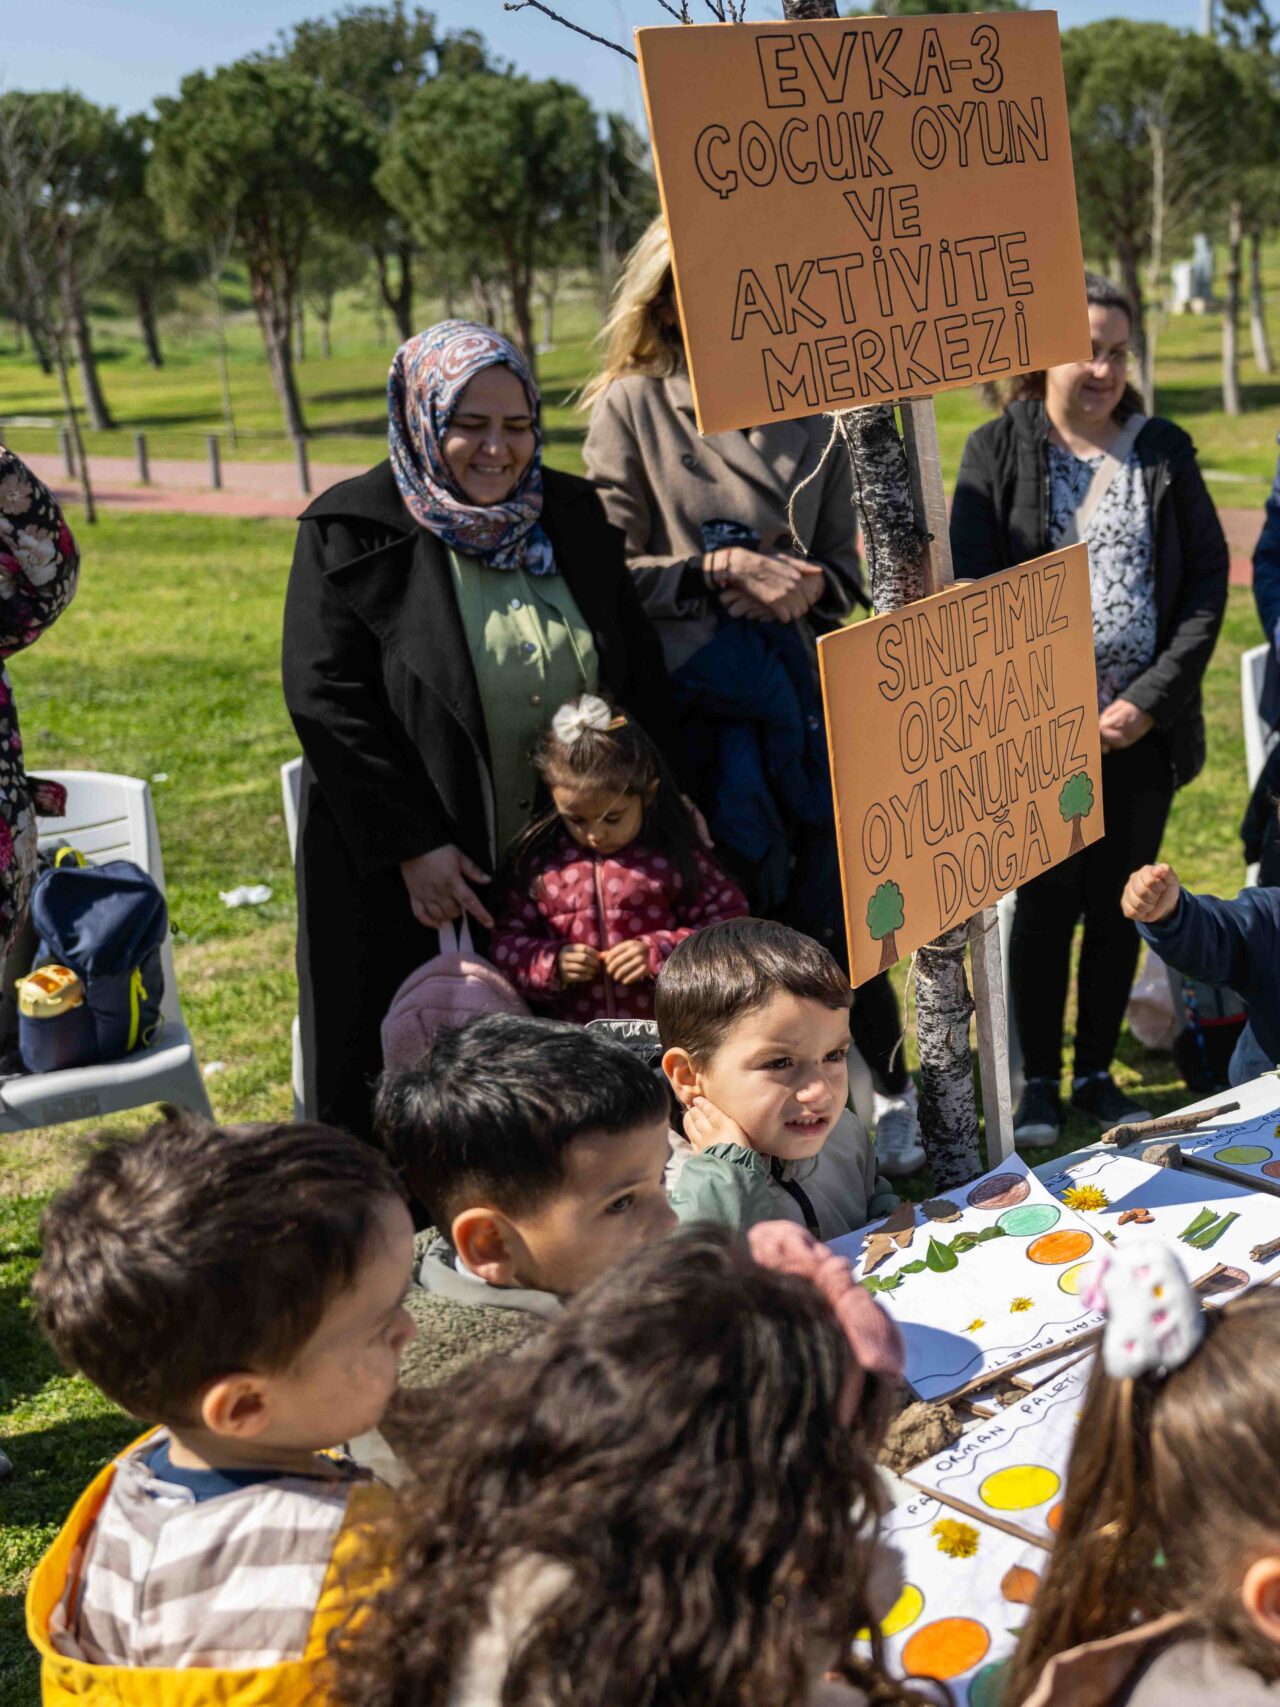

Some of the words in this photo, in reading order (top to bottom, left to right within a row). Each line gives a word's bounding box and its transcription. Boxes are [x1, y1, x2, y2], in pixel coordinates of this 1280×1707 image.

[756, 25, 1004, 108] EVKA-3
[694, 111, 893, 199] ÇOCUK
[911, 97, 1049, 170] OYUN
[843, 184, 921, 242] VE
[876, 561, 1069, 701] SINIFIMIZ
[900, 644, 1056, 774] ORMAN
[862, 706, 1088, 875] OYUNUMUZ
[933, 801, 1051, 930] DOĞA
[1196, 1126, 1247, 1146] ORMAN
[936, 1425, 1006, 1471] ORMAN
